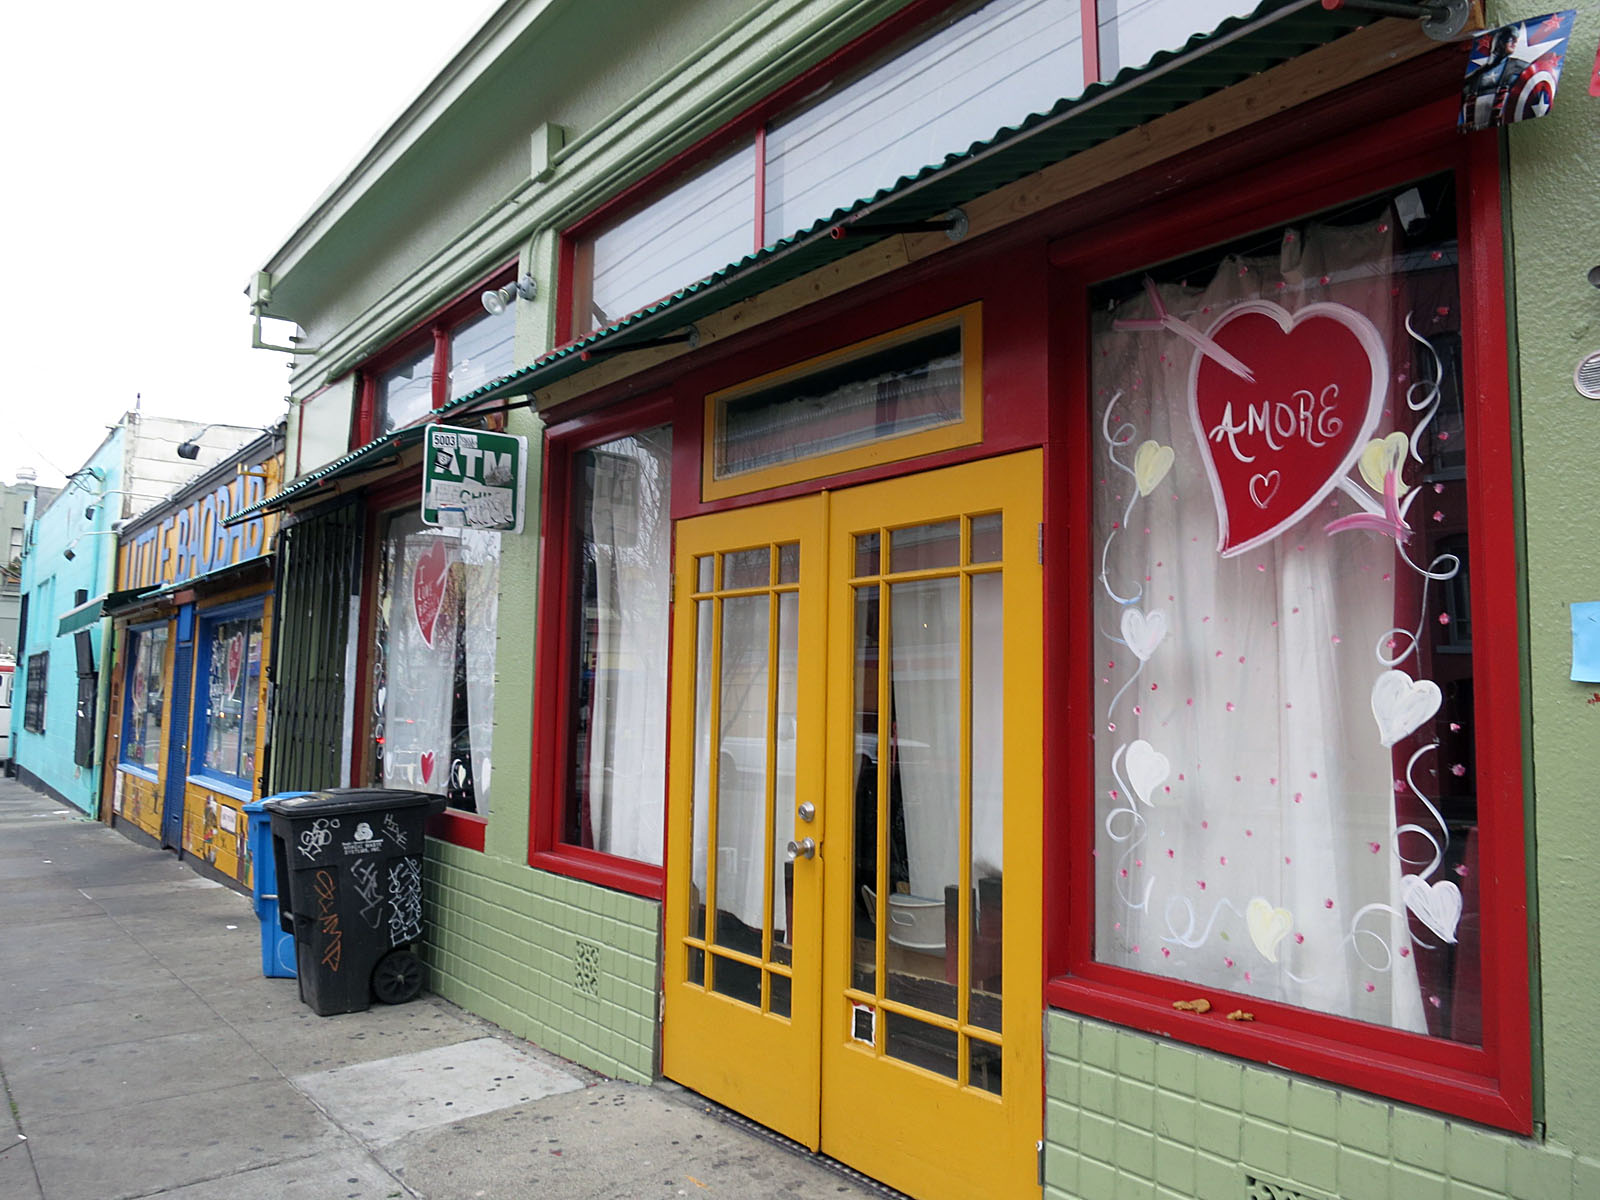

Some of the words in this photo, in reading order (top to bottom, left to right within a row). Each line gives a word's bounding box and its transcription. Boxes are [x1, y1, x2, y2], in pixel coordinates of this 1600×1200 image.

[434, 434, 456, 446] 5003
[1209, 384, 1343, 463] AMORE
[434, 447, 512, 485] ATM
[174, 464, 265, 583] BAOBAB
